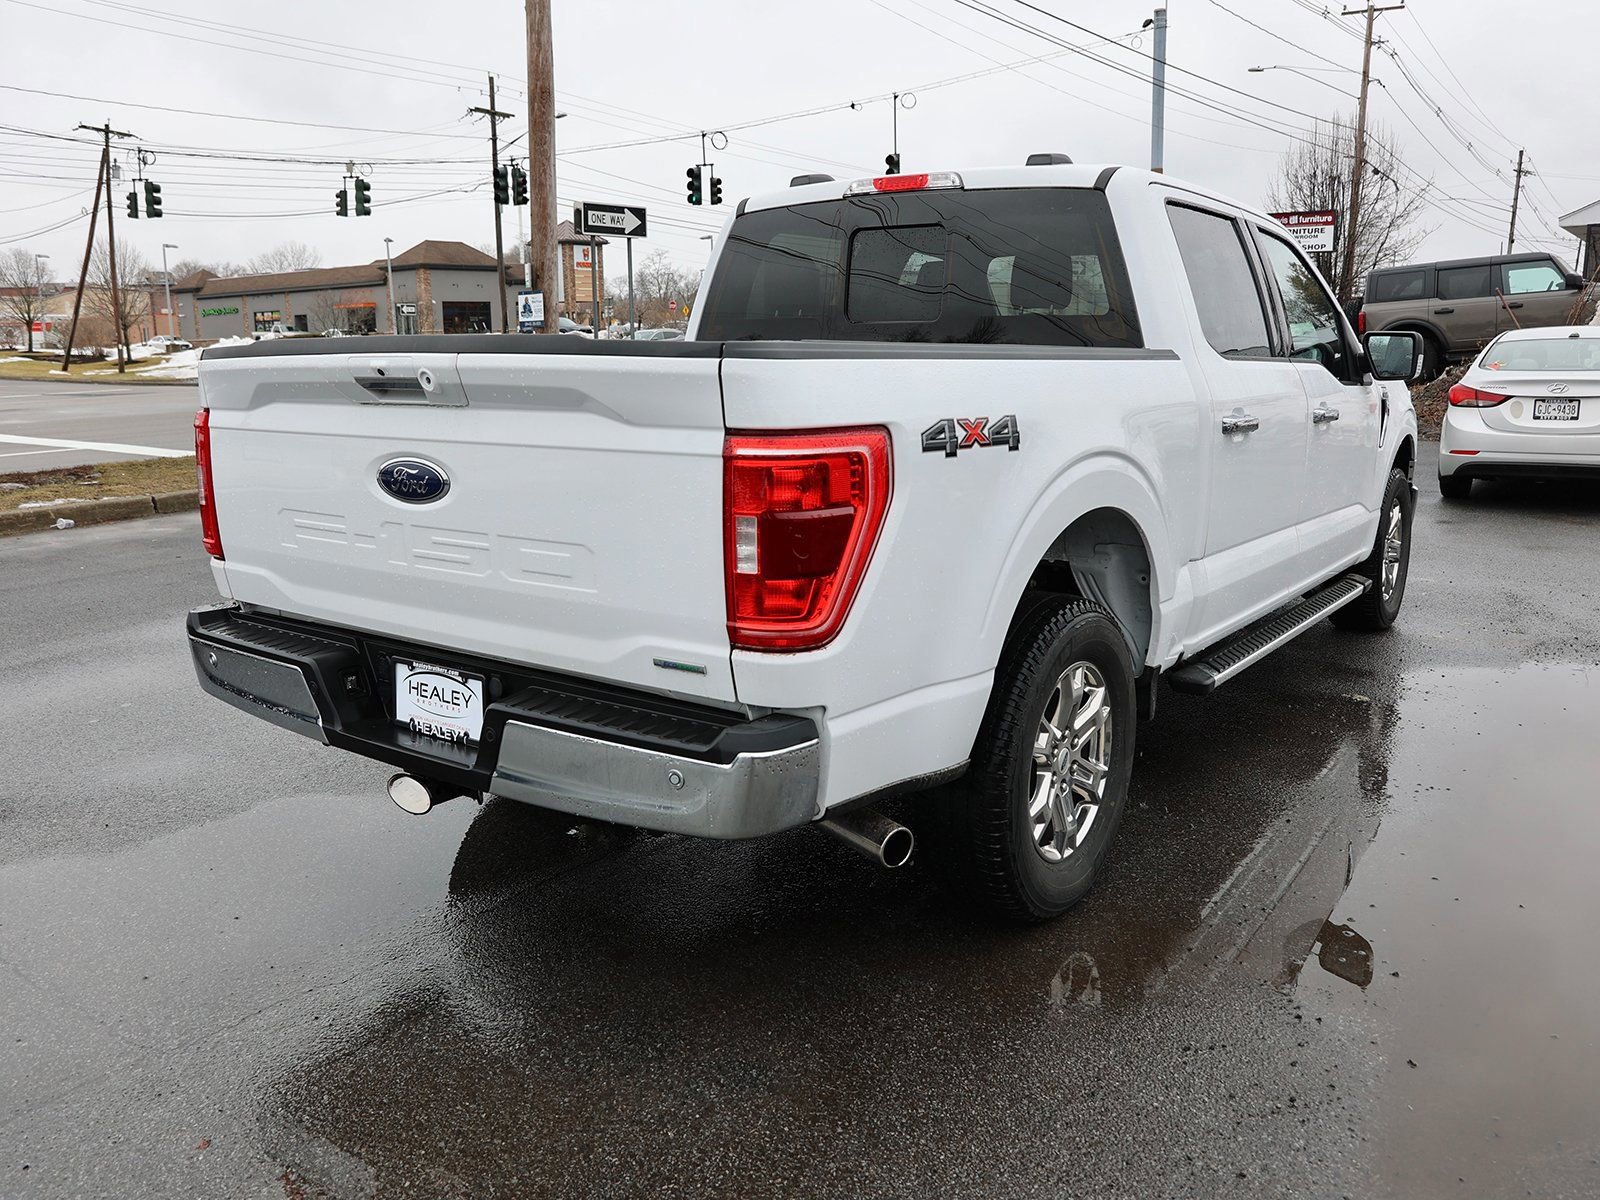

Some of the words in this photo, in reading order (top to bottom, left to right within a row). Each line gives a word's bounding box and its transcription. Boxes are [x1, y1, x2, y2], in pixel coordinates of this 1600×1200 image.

[591, 213, 606, 225] ONE
[610, 215, 625, 226] WAY
[1299, 215, 1333, 223] furniture
[391, 466, 429, 494] Ford
[277, 507, 599, 593] F-150
[413, 661, 459, 676] healeybrothers.com
[409, 680, 472, 708] HEALEY
[416, 698, 461, 713] BROTHERS
[416, 721, 460, 741] HEALEY
